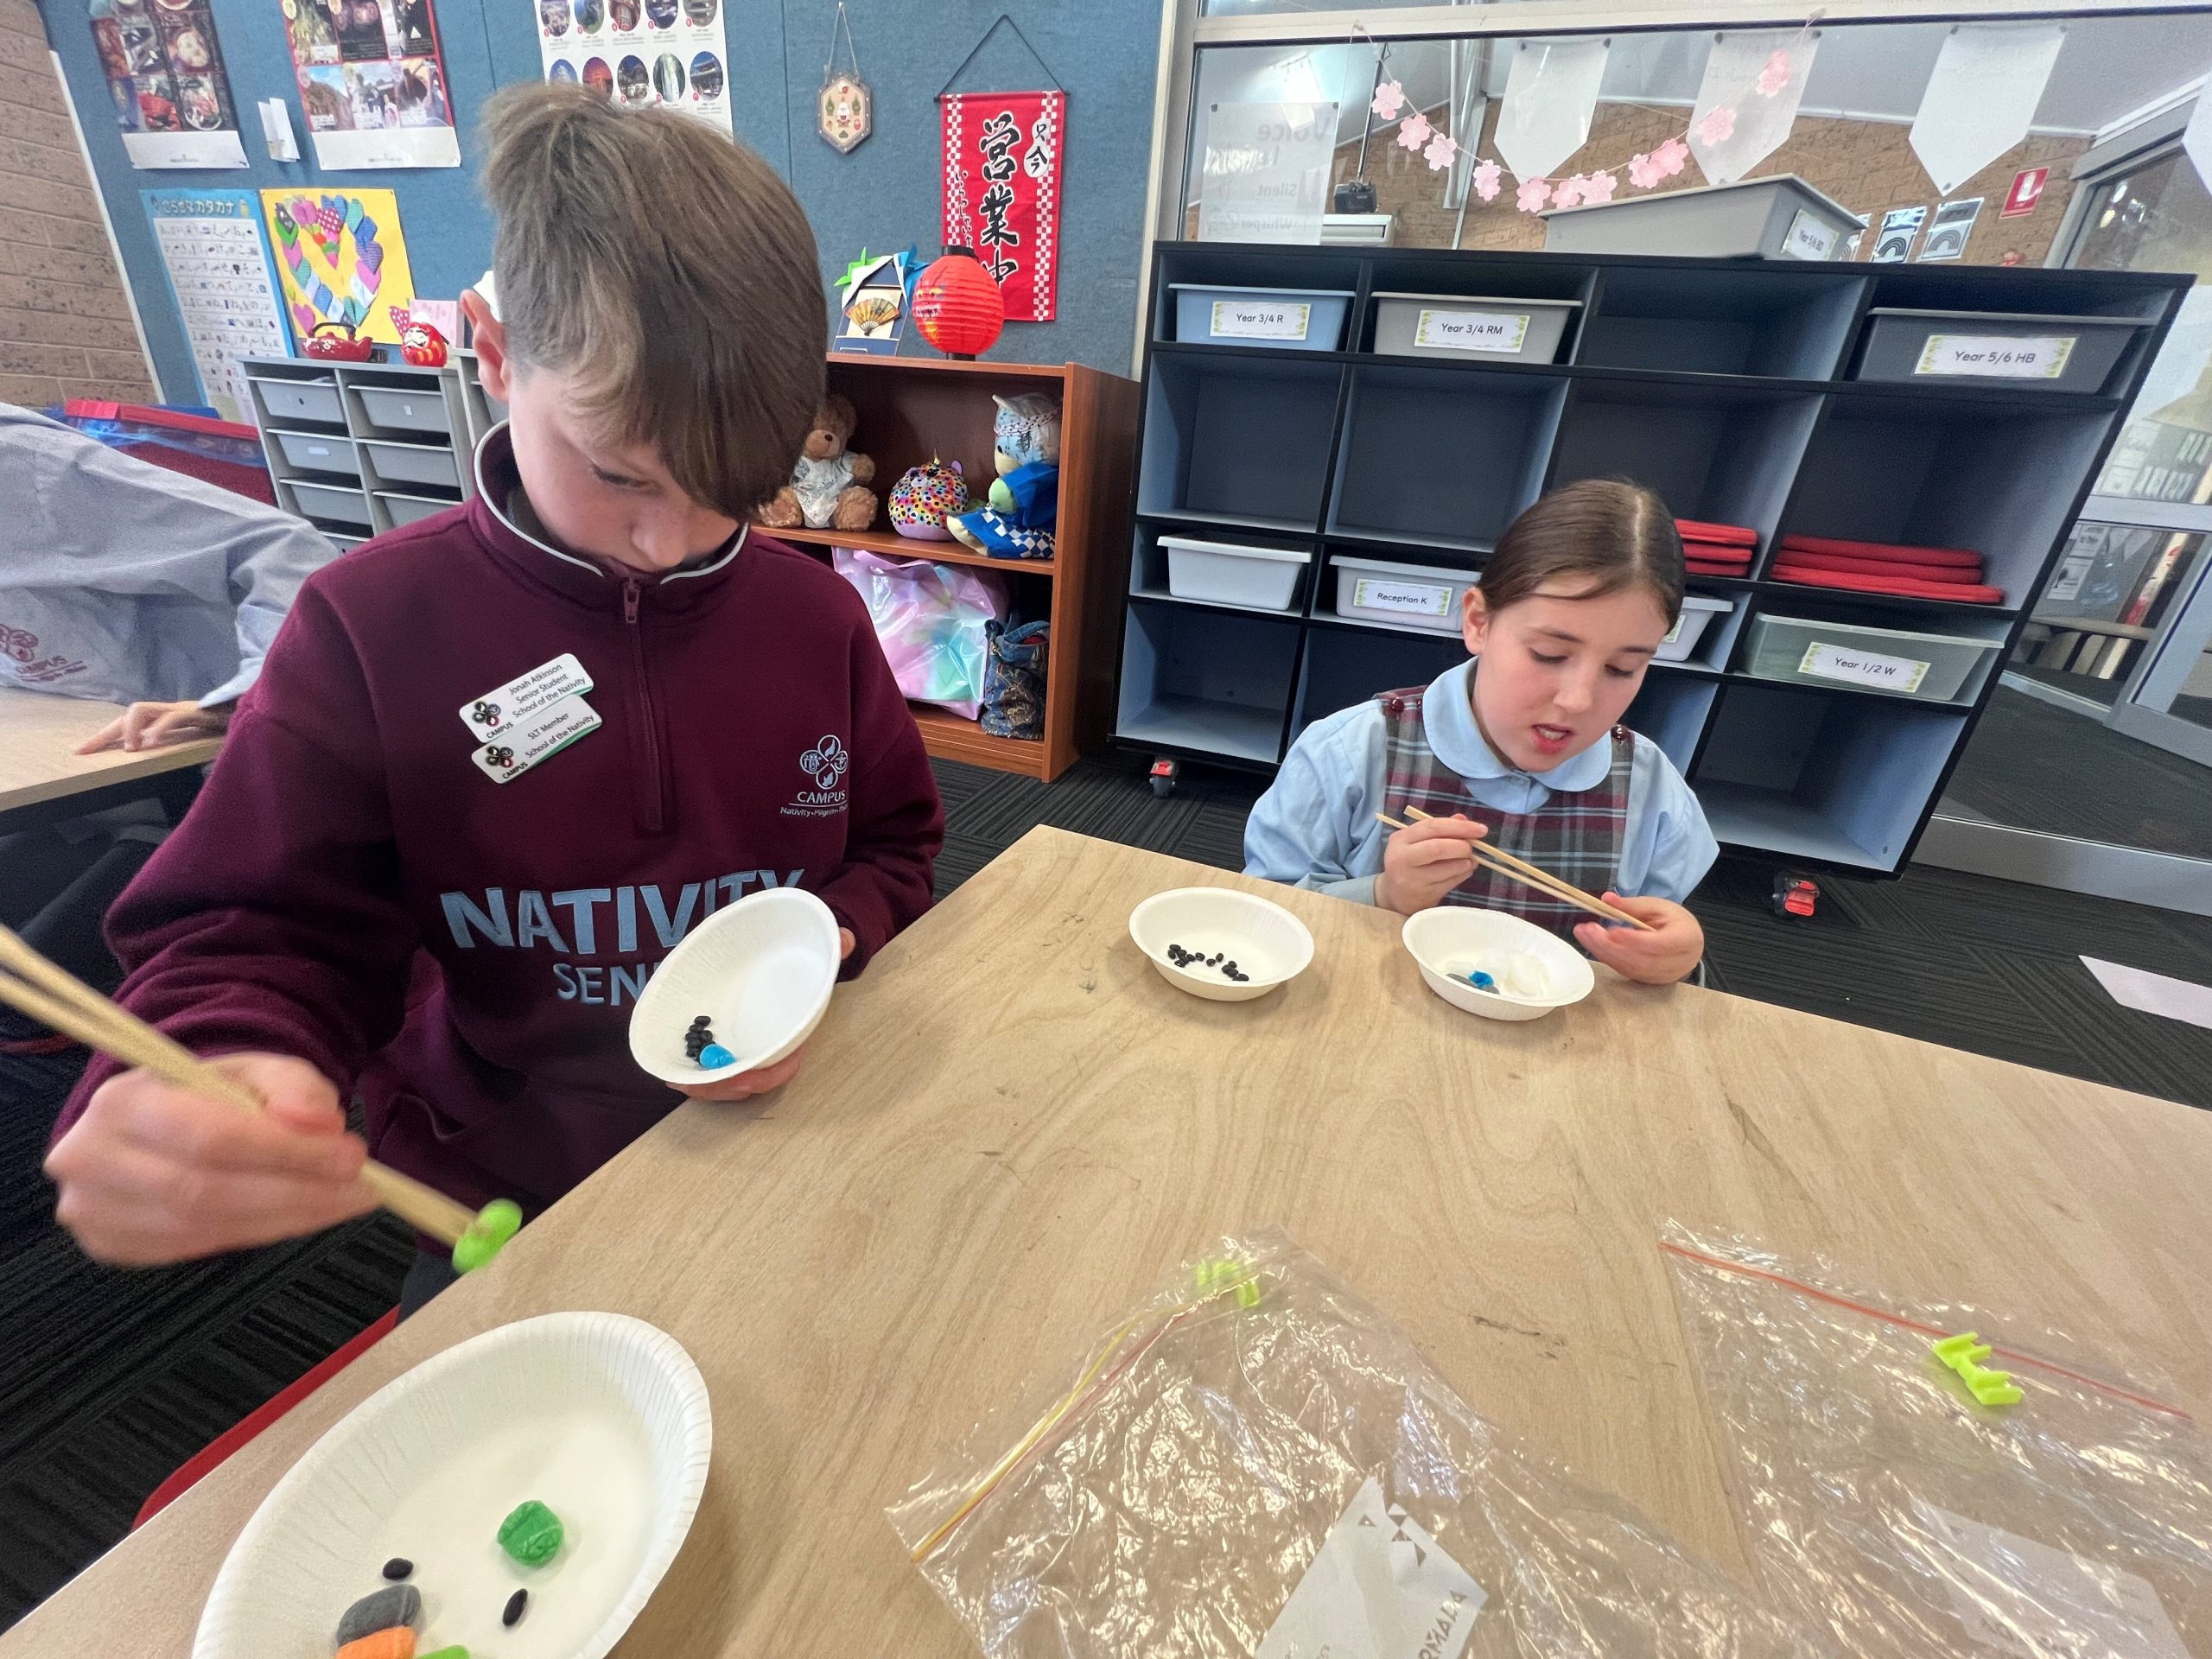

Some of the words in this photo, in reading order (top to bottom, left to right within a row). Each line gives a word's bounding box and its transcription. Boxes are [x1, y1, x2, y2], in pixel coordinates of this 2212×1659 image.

[1236, 313, 1256, 323] Year
[1258, 314, 1274, 325] 3/4
[1277, 315, 1284, 323] R
[1441, 323, 1464, 334] Year
[1465, 324, 1484, 335] 3/4
[1486, 325, 1503, 335] RM
[1955, 351, 1986, 362] Year
[1988, 352, 2012, 365] 5/6
[2014, 353, 2037, 364] HB
[1376, 592, 1419, 604] Reception
[1421, 596, 1427, 605] K
[1834, 657, 1859, 669] Year
[1862, 663, 1882, 674] 1/2
[1885, 666, 1897, 676] W
[508, 680, 531, 695] Jonah
[531, 664, 563, 683] Atkinson
[516, 688, 540, 704] Senior
[538, 673, 569, 693] Student
[512, 701, 539, 718] School
[558, 677, 586, 696] Nativity
[486, 721, 514, 740] CAMPUS
[527, 728, 541, 741] SLT
[541, 713, 570, 734] Member
[524, 741, 550, 759] School
[567, 715, 594, 734] Nativity
[502, 761, 529, 779] CAMPUS
[797, 790, 846, 804] CAMPUS
